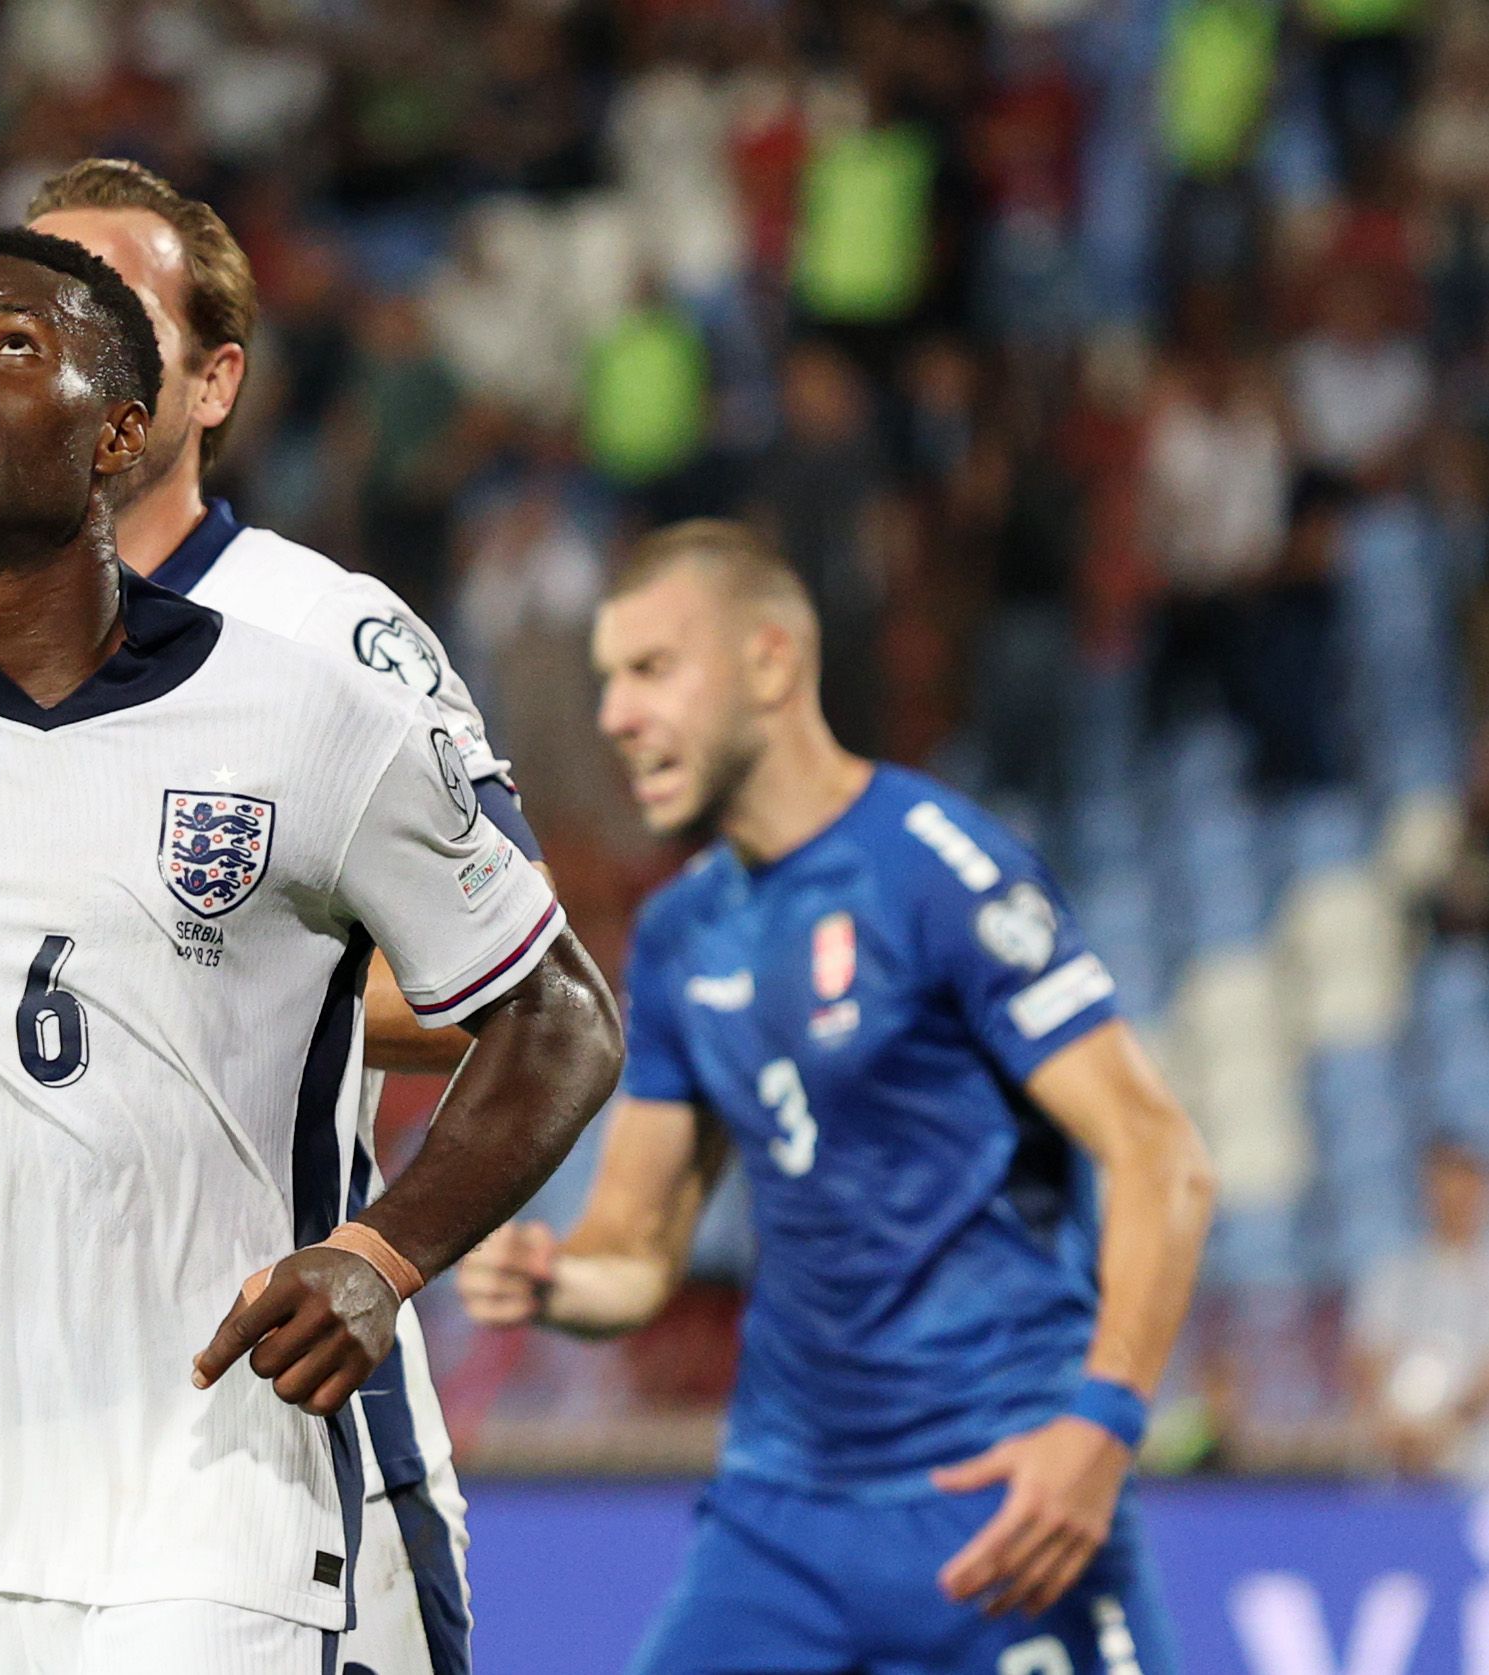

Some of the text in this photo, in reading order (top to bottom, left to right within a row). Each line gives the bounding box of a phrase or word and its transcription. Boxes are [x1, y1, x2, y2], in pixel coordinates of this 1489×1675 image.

[176, 920, 223, 945] SERBIA
[16, 934, 89, 1088] 6
[756, 1056, 819, 1178] 3
